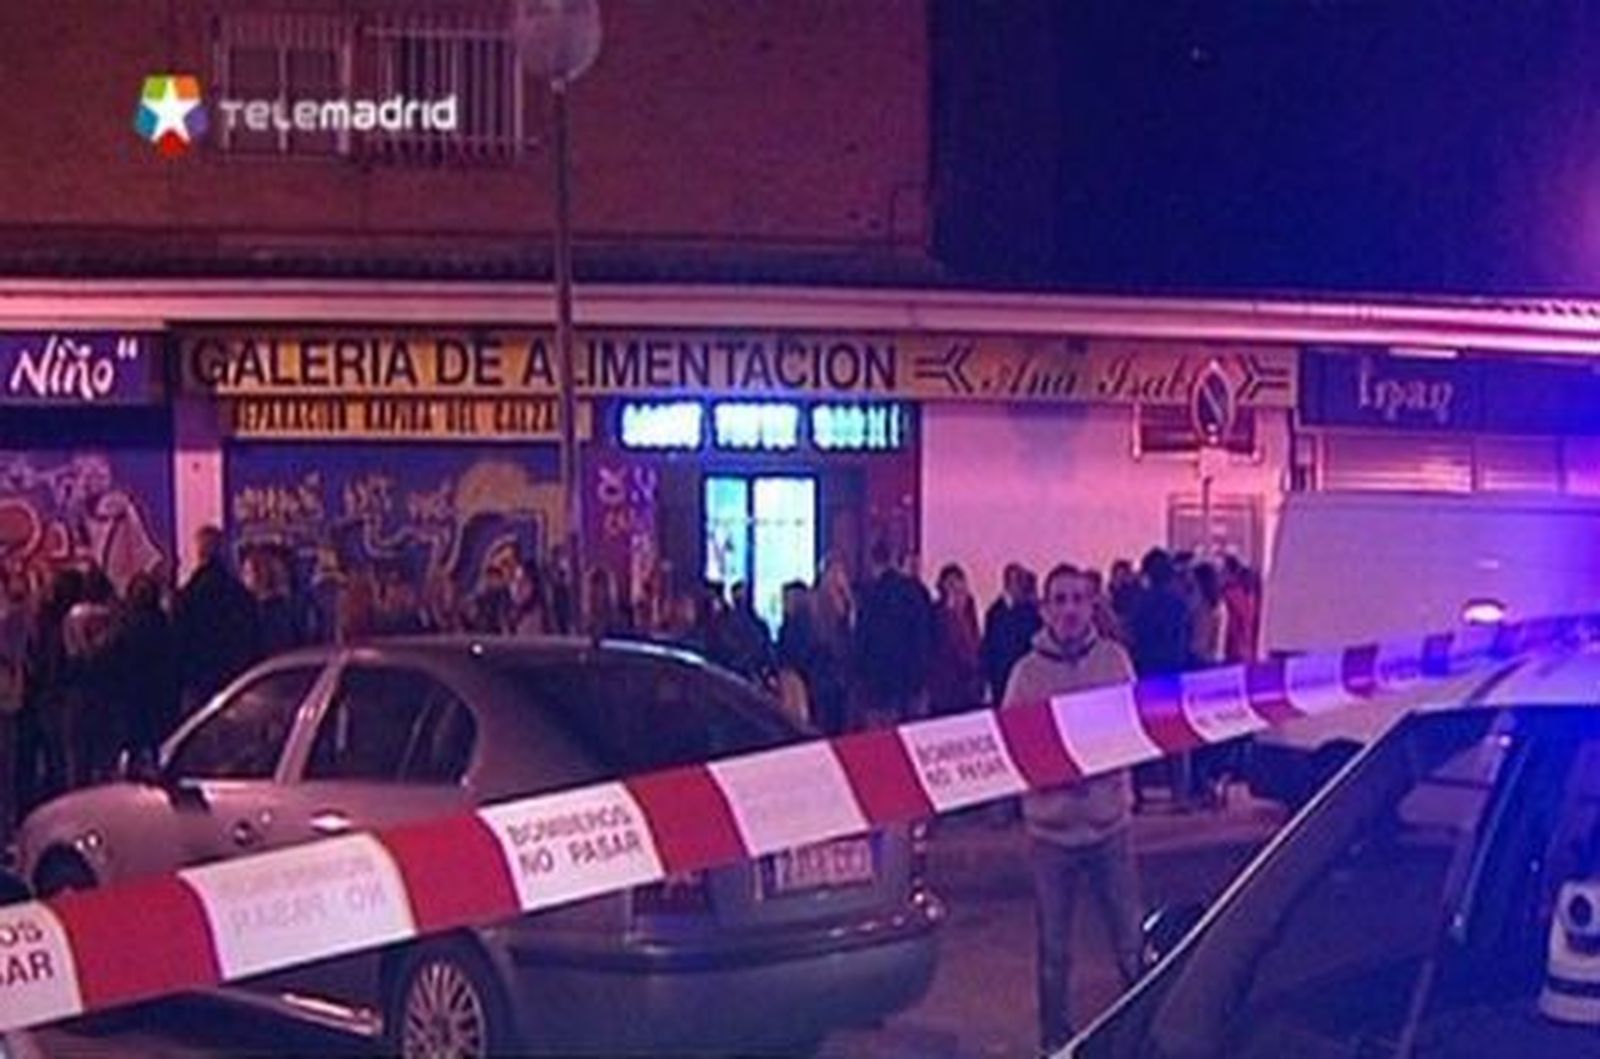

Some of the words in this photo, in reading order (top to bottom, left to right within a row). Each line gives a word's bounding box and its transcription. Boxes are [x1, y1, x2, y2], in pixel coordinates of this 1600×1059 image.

[192, 338, 416, 388] GALERIA
[436, 339, 503, 387] DE
[506, 803, 634, 847] BOMBEROS
[518, 847, 555, 877] NO
[568, 828, 644, 864] PASAR
